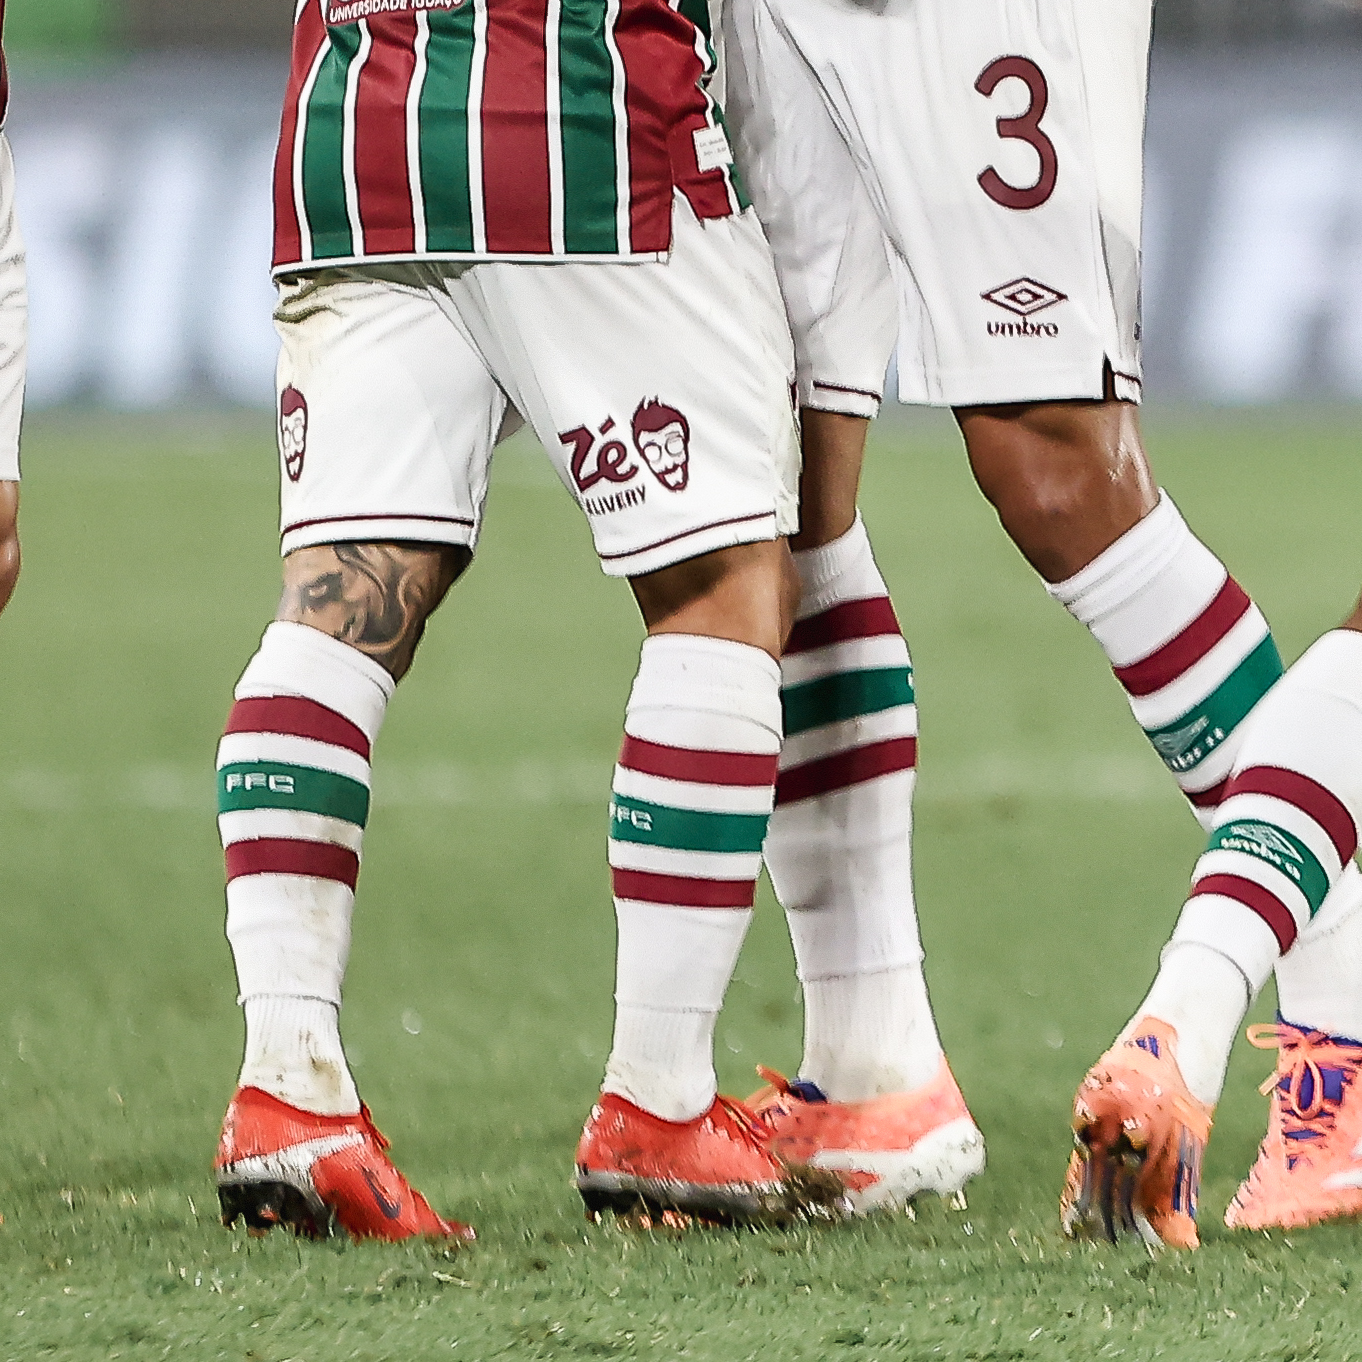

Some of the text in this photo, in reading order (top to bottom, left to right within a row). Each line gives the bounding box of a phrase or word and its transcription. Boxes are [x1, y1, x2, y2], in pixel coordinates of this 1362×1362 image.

[974, 54, 1059, 211] 3
[986, 316, 1059, 338] umbro
[557, 414, 639, 494] Zé
